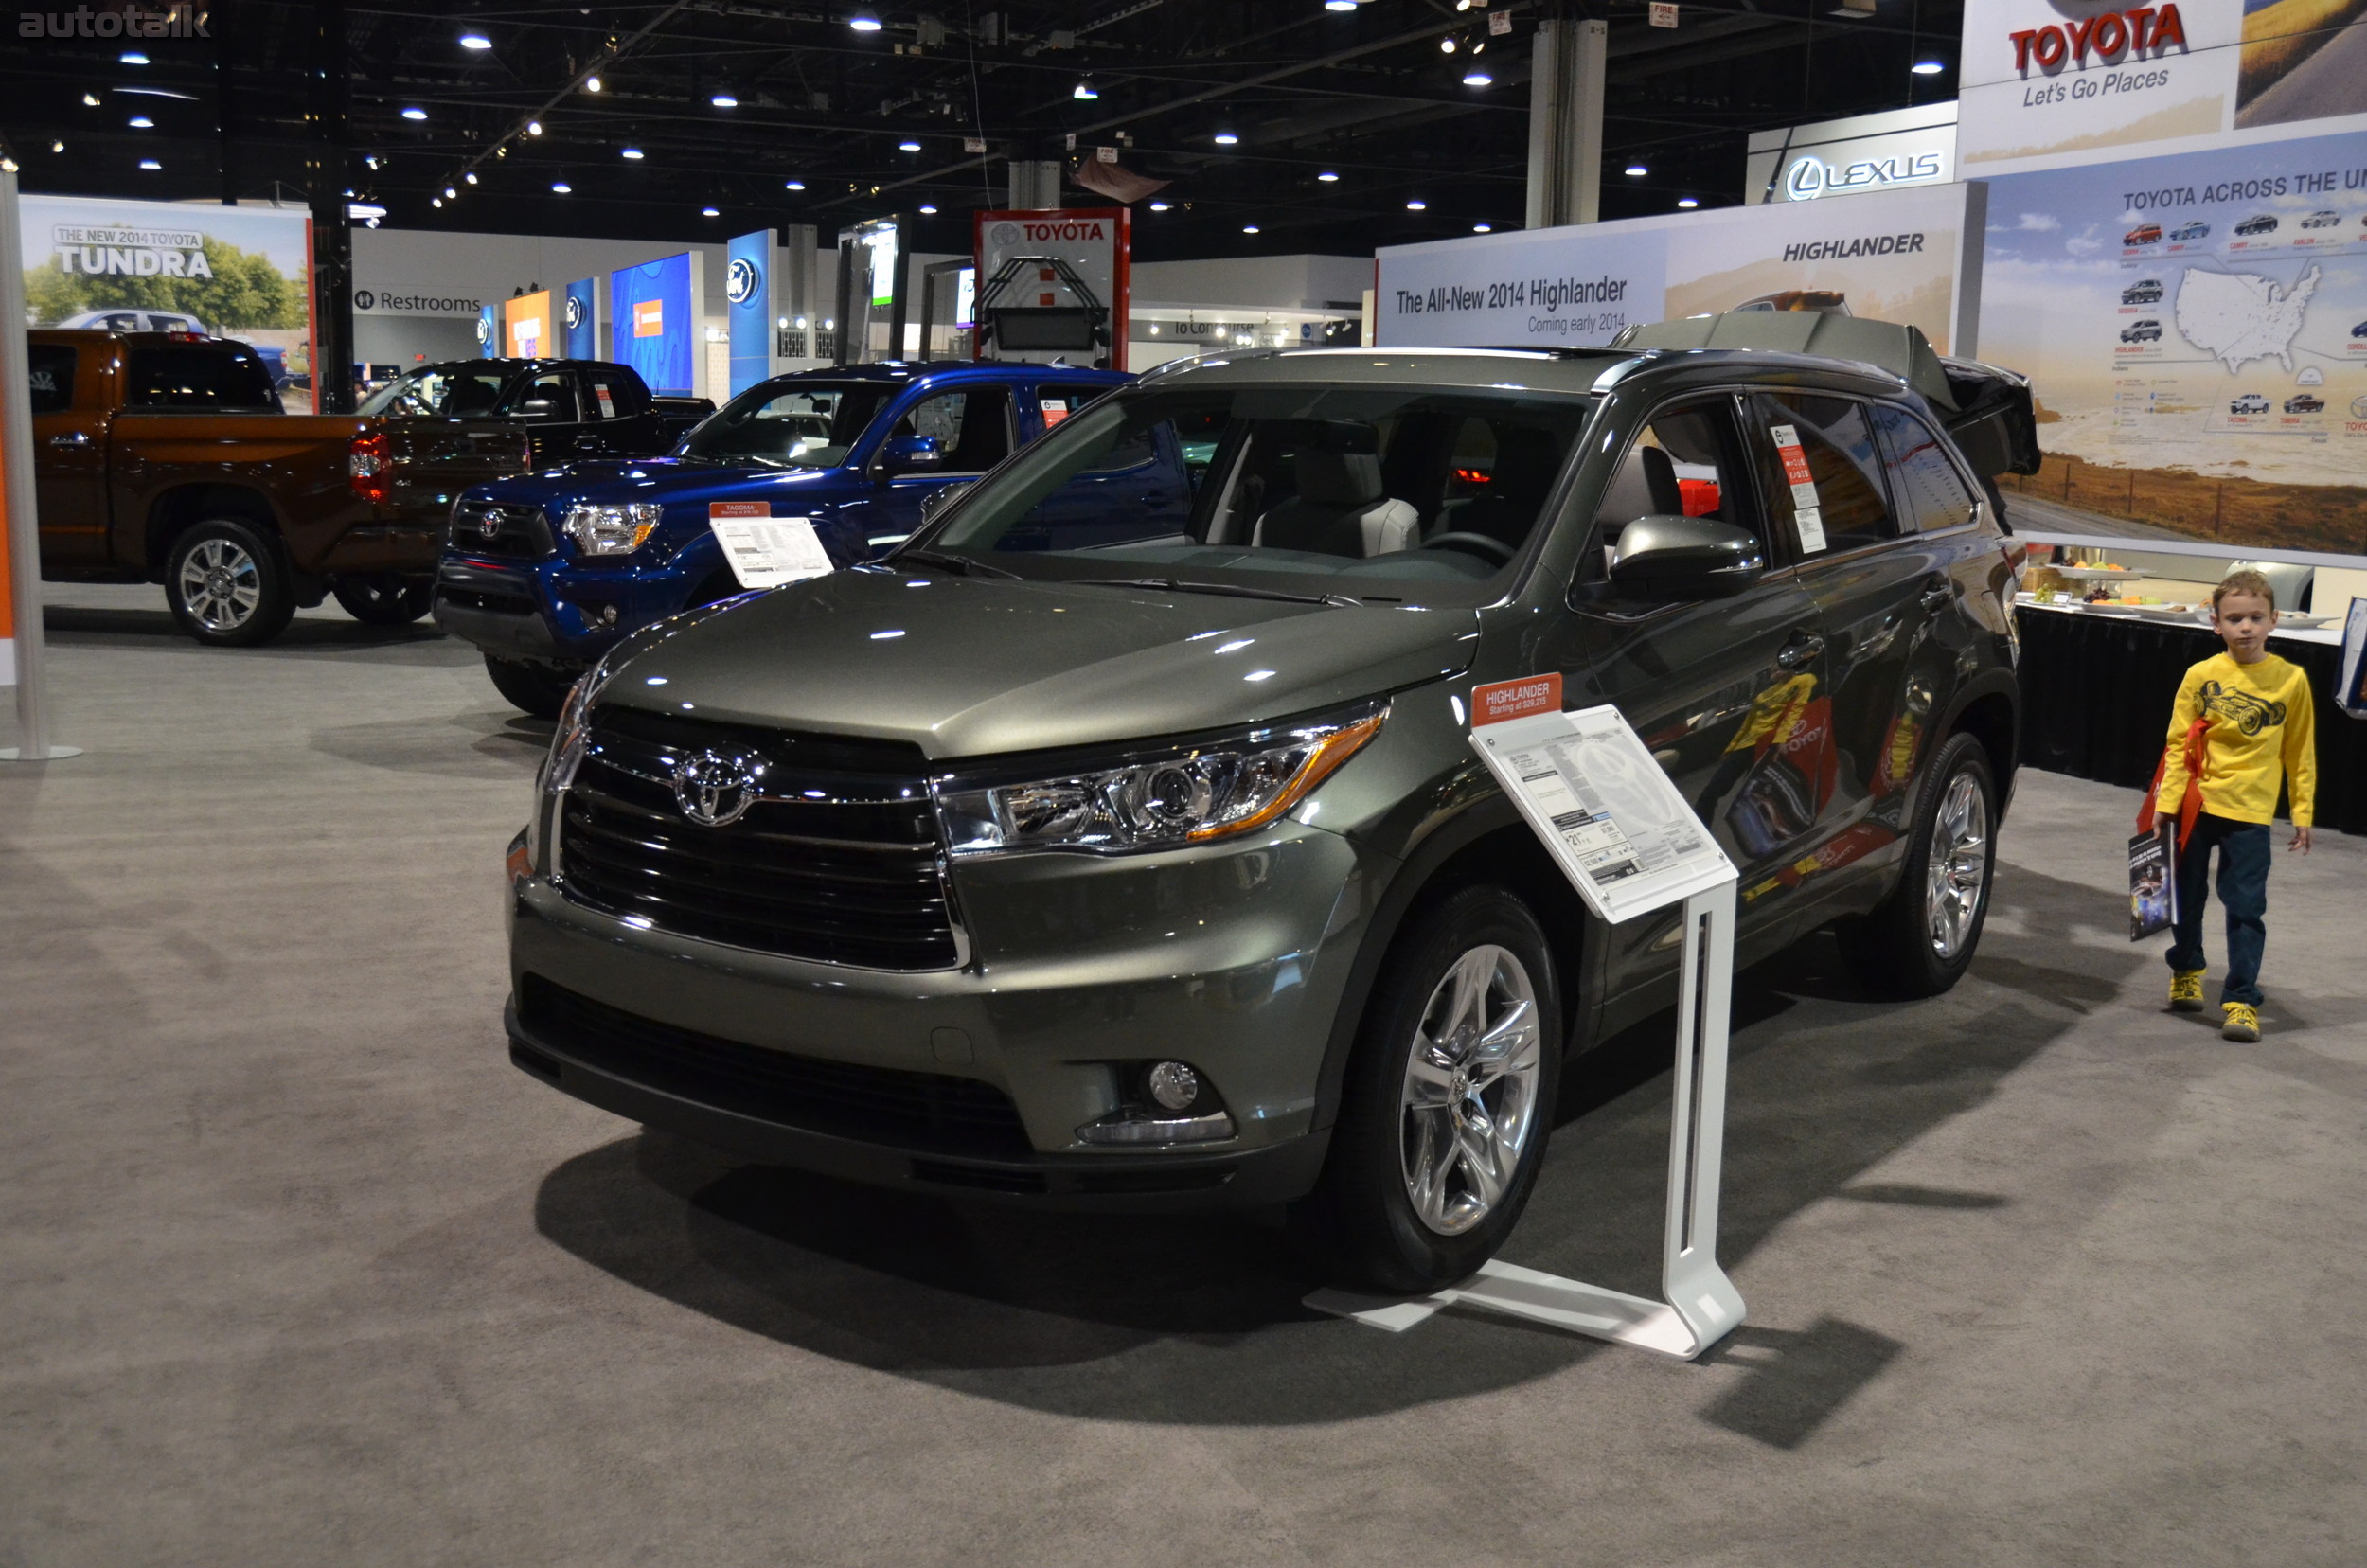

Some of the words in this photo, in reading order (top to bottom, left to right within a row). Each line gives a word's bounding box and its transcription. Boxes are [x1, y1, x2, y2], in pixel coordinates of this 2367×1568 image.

[1654, 5, 1673, 13] FIRE
[2008, 3, 2185, 70] TOYOTA
[2023, 83, 2066, 107] Let's
[2072, 78, 2097, 99] Go
[2101, 69, 2169, 95] Places
[1825, 153, 1941, 188] LEXUS
[2123, 187, 2196, 210] TOYOTA
[2201, 177, 2287, 204] ACROSS
[2295, 171, 2337, 193] THE
[58, 228, 82, 241] THE
[86, 230, 116, 242] NEW
[119, 232, 148, 244] 2014
[149, 233, 199, 246] TOYOTA
[1023, 223, 1104, 241] TOYOTA
[55, 245, 214, 278] TUNDRA
[1782, 233, 1925, 263] HIGHLANDER
[381, 293, 481, 312] Restrooms
[1397, 291, 1422, 314] The
[1427, 286, 1485, 312] All-New
[1488, 281, 1524, 309] 2014
[1530, 276, 1627, 312] Highlander
[1528, 315, 1568, 335] Coming
[1571, 313, 1596, 333] early
[1599, 312, 1625, 330] 2014
[1486, 682, 1550, 706] HIGHLANDER
[1489, 704, 1514, 715] Starting
[1515, 702, 1522, 710] at
[1522, 697, 1546, 708] $29,215
